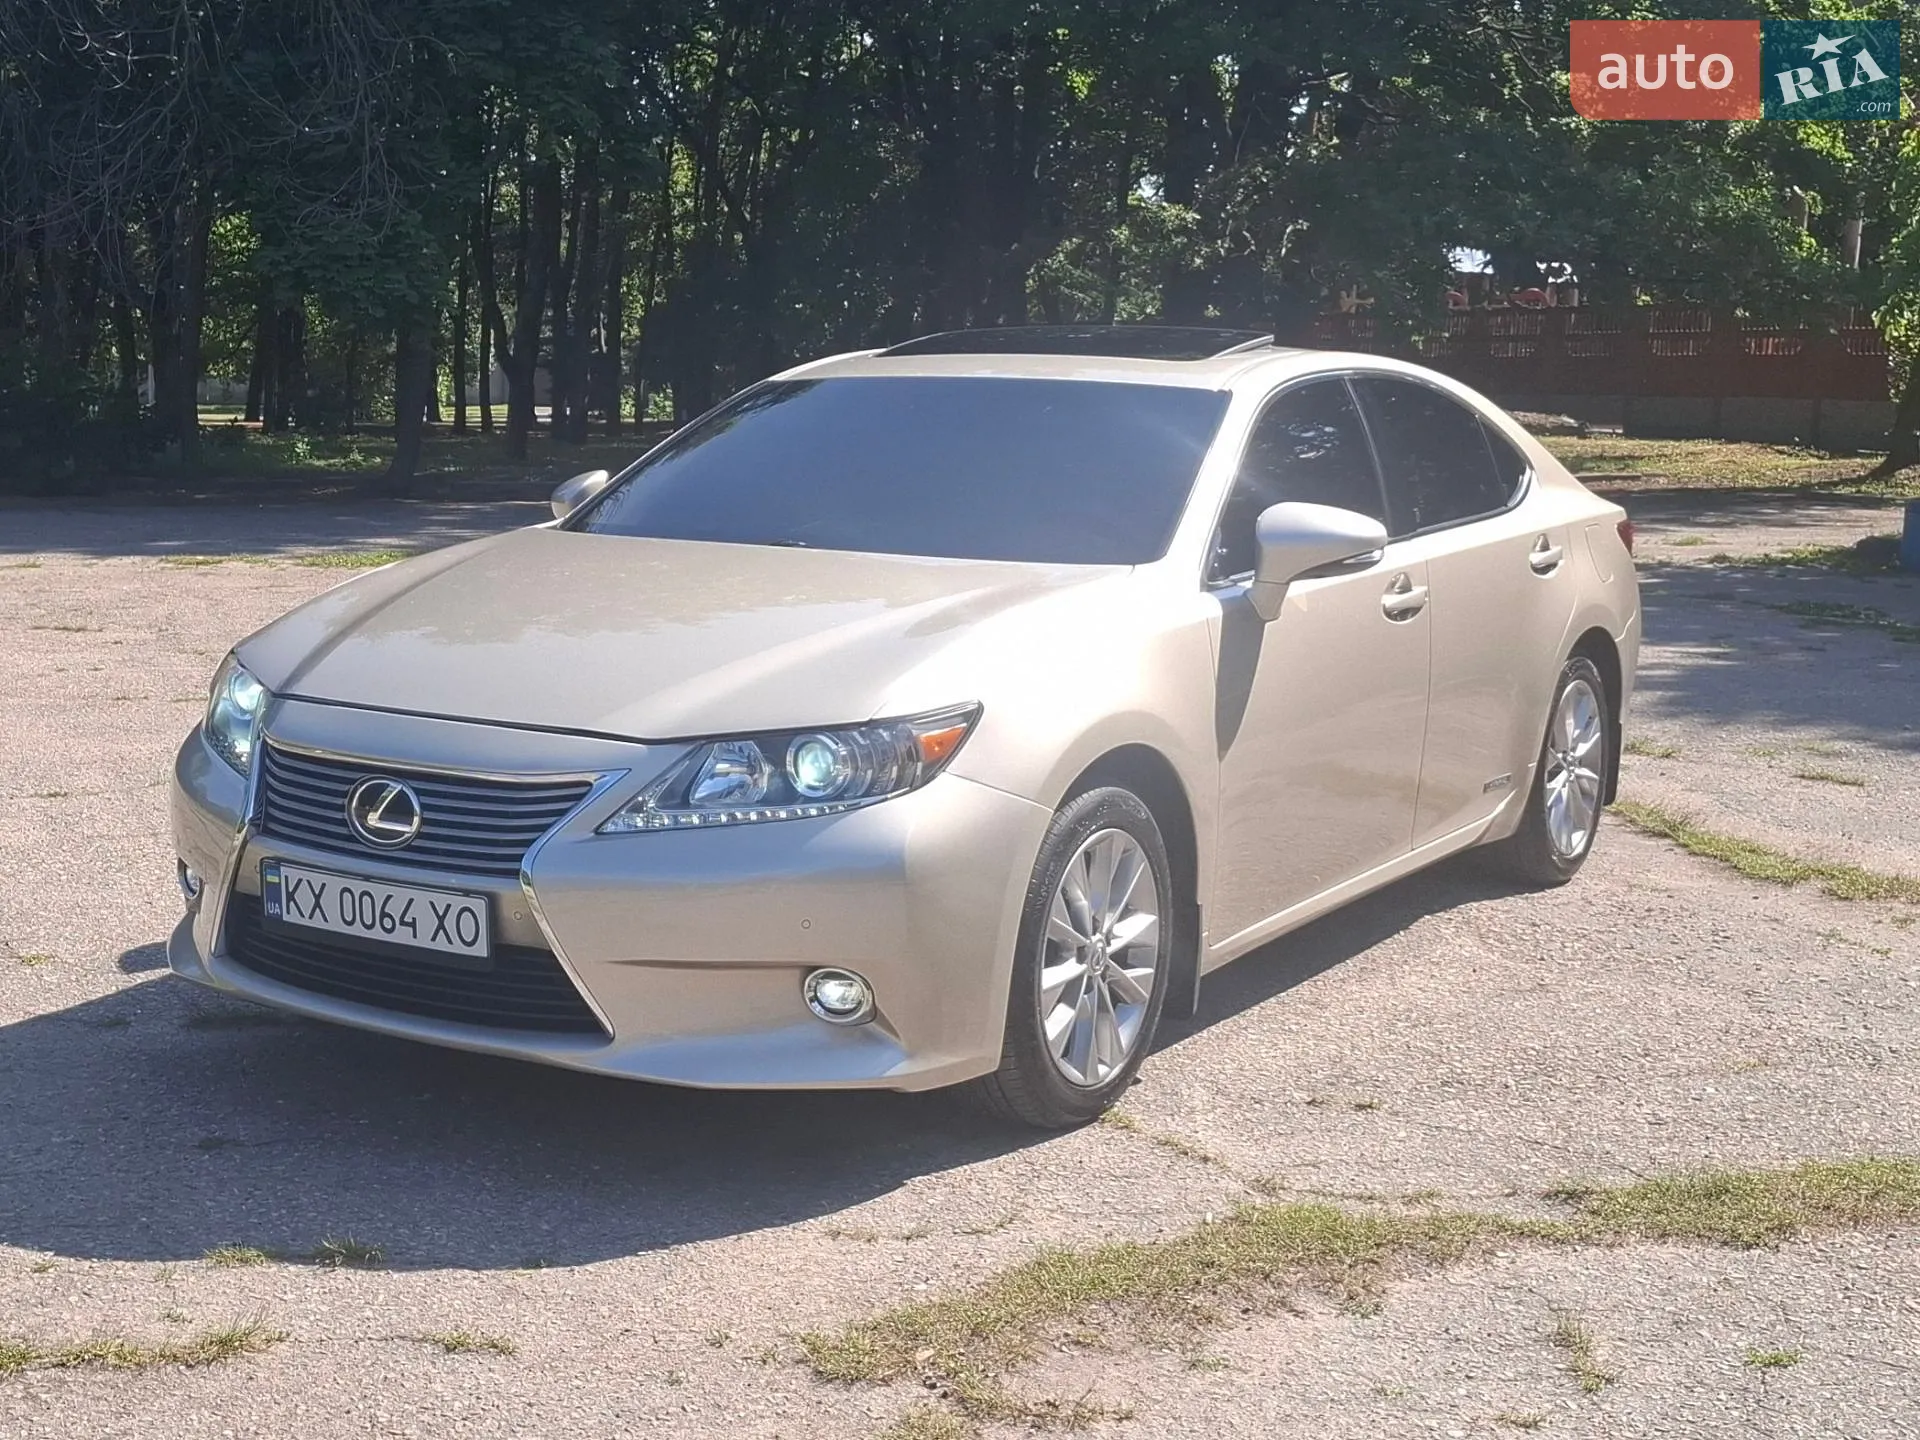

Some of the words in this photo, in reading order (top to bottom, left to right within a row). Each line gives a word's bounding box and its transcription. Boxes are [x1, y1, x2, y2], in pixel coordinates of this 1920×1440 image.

[267, 901, 281, 915] UA
[284, 875, 329, 923] KX
[339, 886, 418, 939] 0064
[429, 900, 480, 948] XO
